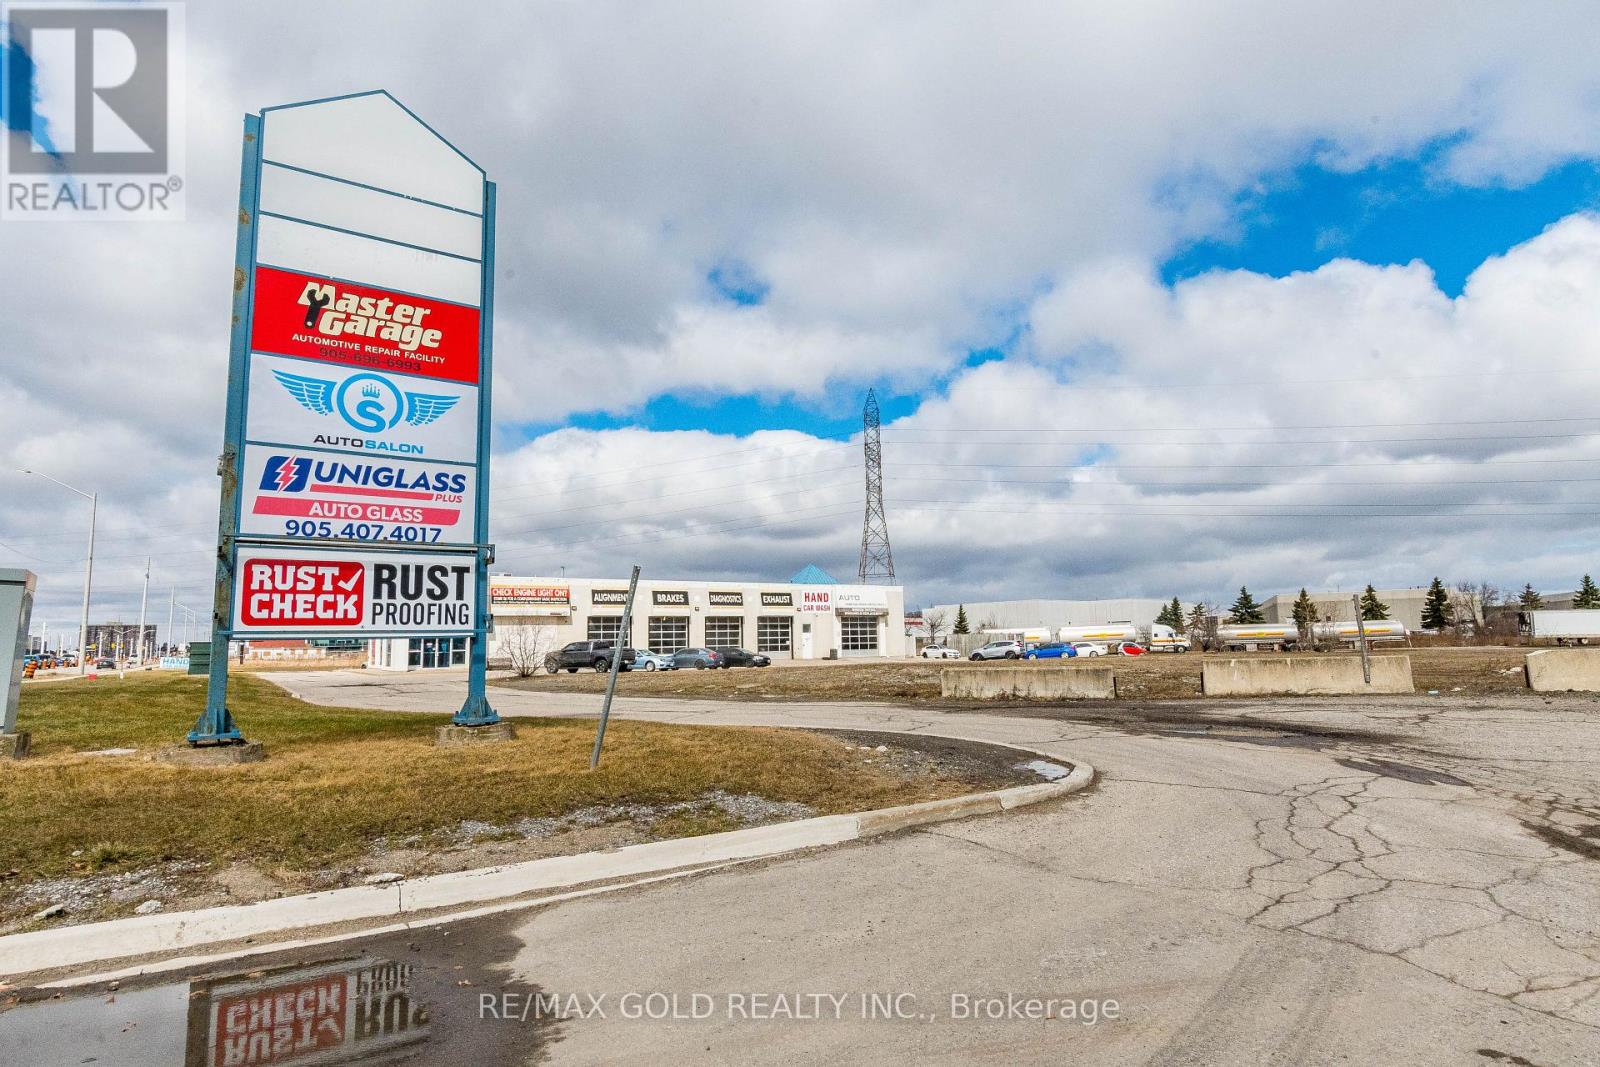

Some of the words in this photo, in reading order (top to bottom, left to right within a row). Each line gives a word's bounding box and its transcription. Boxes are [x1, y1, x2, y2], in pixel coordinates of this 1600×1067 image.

[297, 281, 431, 326] Master
[318, 310, 443, 351] Garage
[292, 333, 361, 351] AUTOMOTIVE
[364, 345, 400, 357] REPAIR
[404, 351, 445, 364] FACILITY
[314, 461, 466, 493] UNIGLASS
[434, 493, 463, 504] PLUS
[308, 502, 362, 519] AUTO
[366, 505, 424, 522] GLASS
[285, 519, 442, 543] 905.407.4017
[250, 564, 339, 591] RUST
[373, 563, 471, 601] RUST
[492, 588, 513, 596] CHECK
[514, 588, 536, 597] ENGINE
[537, 589, 553, 597] LIGHT
[657, 594, 685, 603] BRAKES
[710, 594, 742, 603] DIAGNOSTICS
[763, 595, 790, 604] EXHAUST
[804, 592, 829, 603] HAND
[250, 593, 358, 619] CHECK
[371, 602, 470, 626] PROOFING
